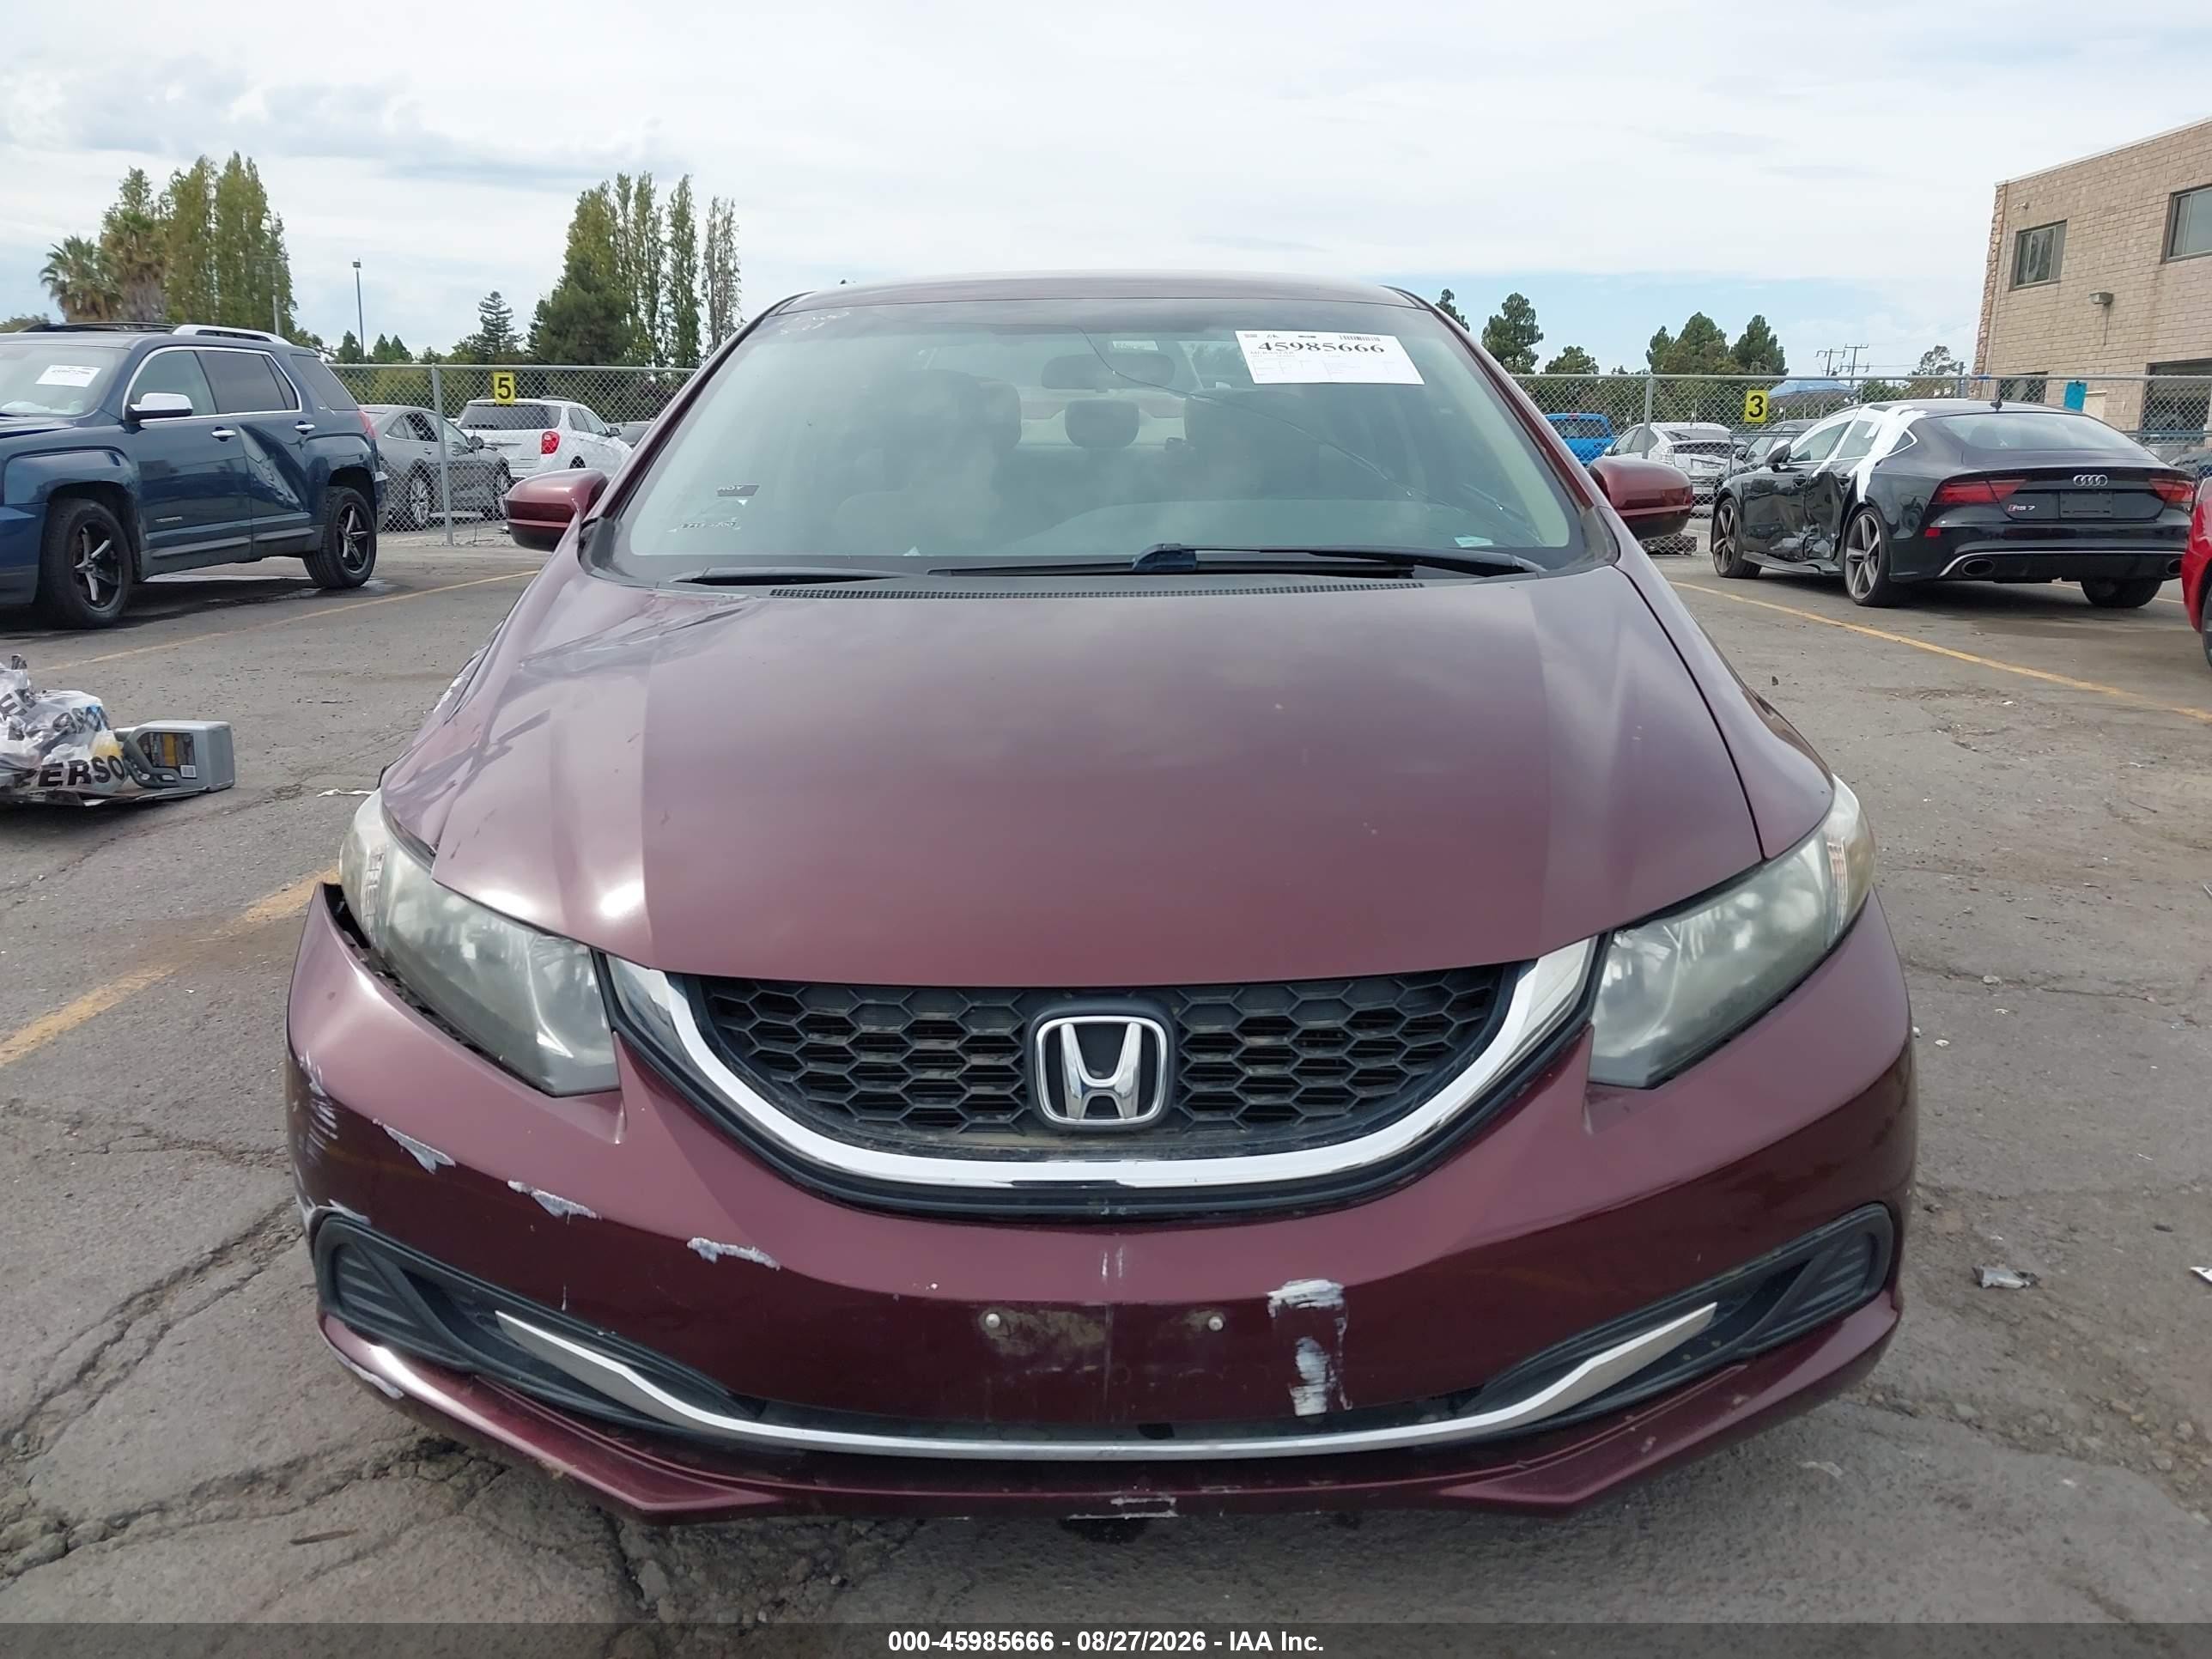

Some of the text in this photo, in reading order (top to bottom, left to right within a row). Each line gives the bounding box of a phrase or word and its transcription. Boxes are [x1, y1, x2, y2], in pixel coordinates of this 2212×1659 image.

[1258, 342, 1385, 353] 45985666
[497, 377, 511, 399] 5
[1748, 395, 1764, 417] 3
